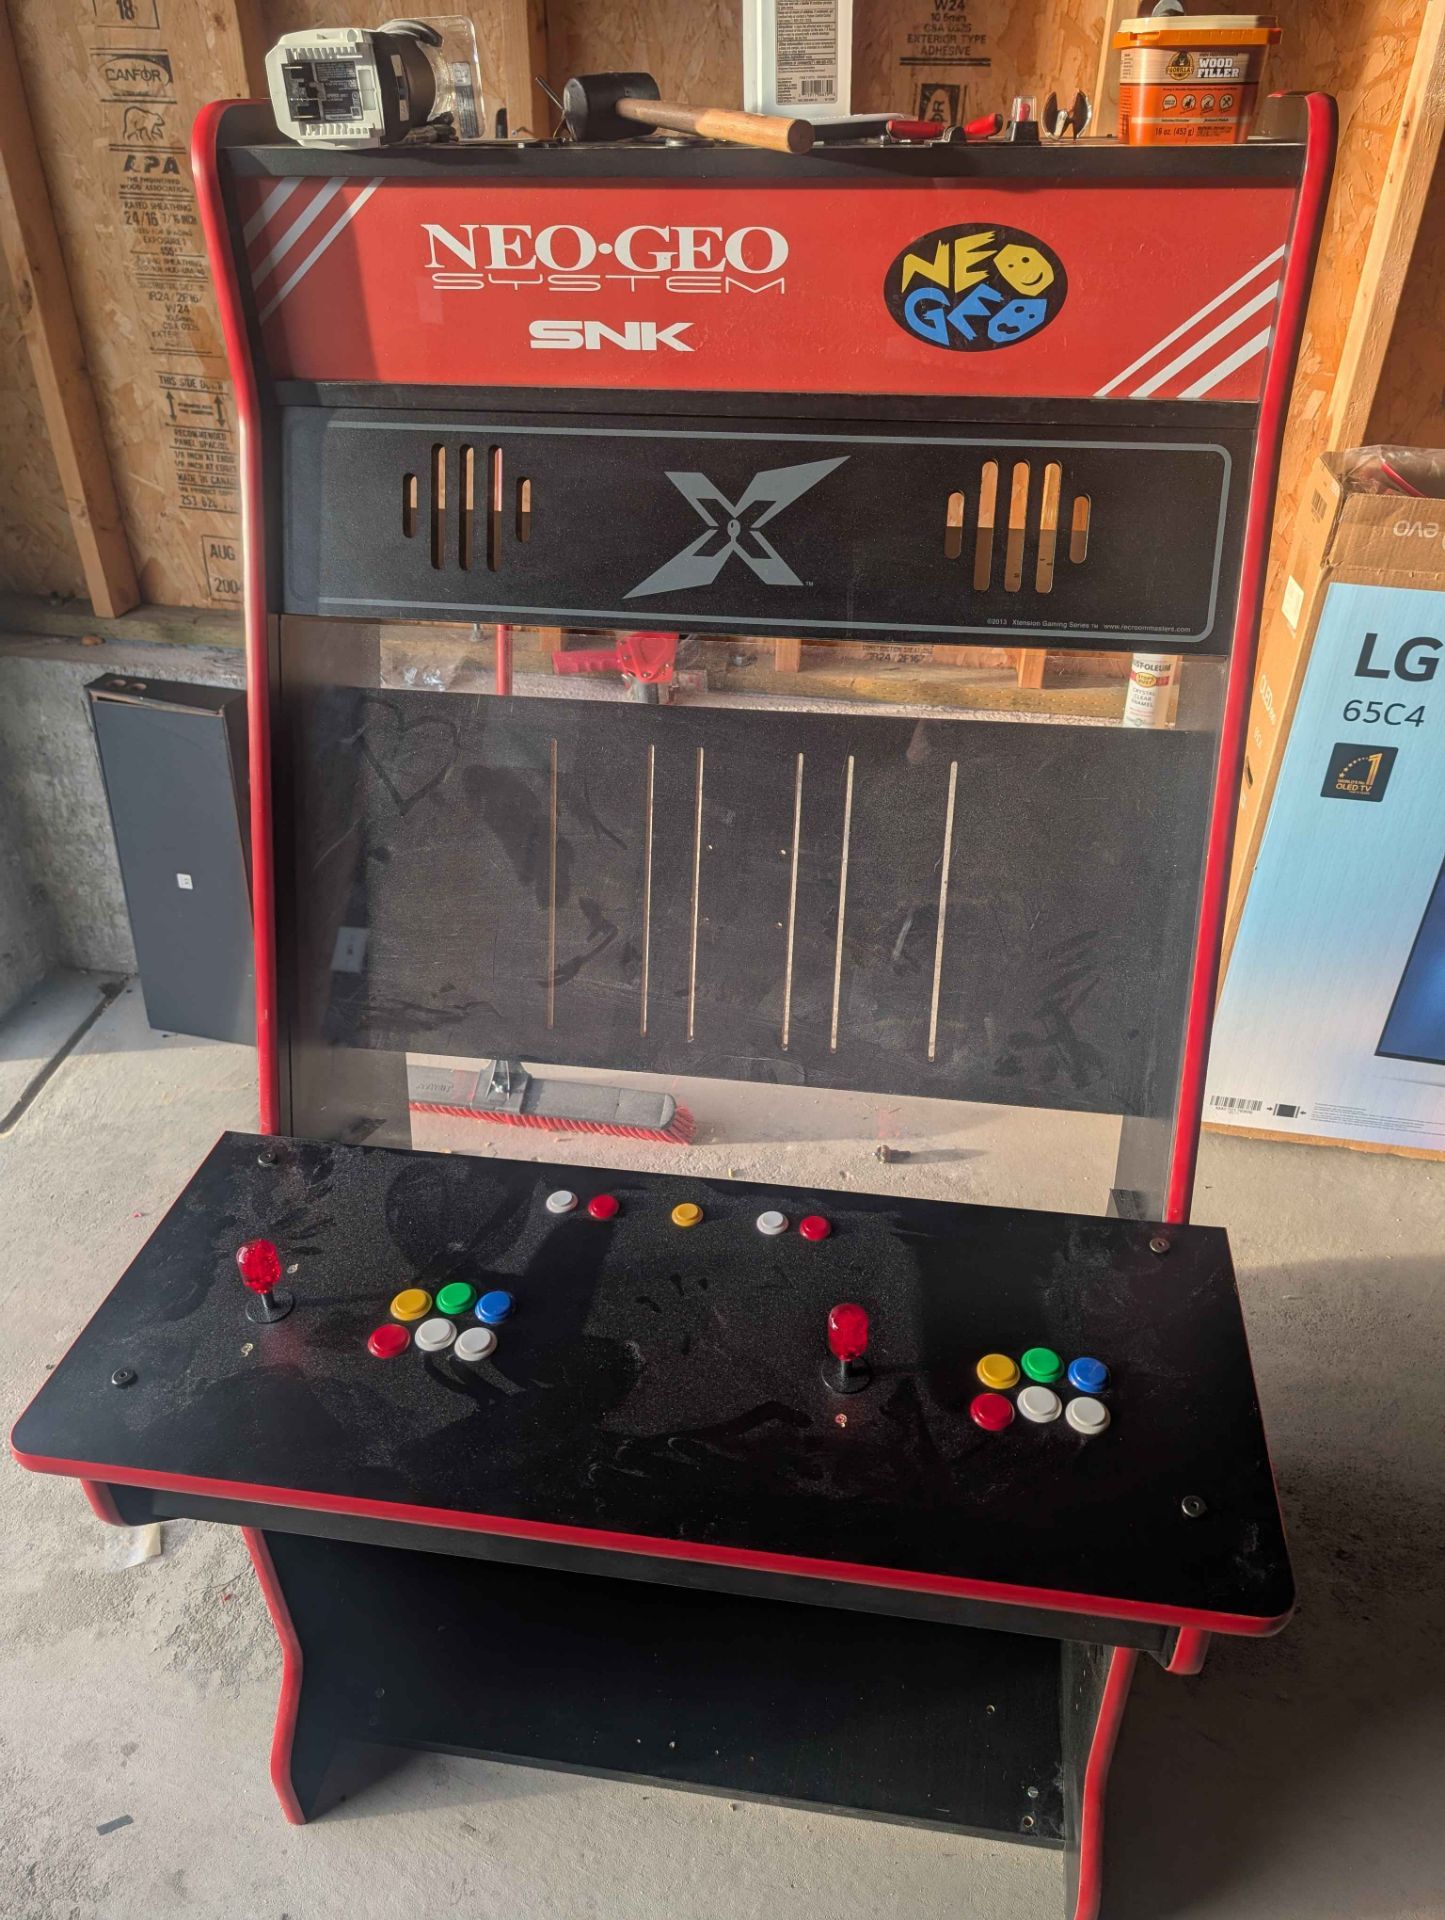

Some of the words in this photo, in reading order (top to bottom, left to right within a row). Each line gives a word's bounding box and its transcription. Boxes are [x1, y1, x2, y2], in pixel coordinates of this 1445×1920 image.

[907, 34, 957, 44] EXTERIOR
[961, 34, 986, 44] TYPE
[921, 45, 971, 56] ADHESIVE
[1199, 58, 1233, 68] WOOD
[105, 66, 161, 84] CANFOR
[1197, 68, 1240, 78] FILLER
[124, 154, 180, 175] APA
[124, 202, 148, 210] RATED
[150, 203, 193, 212] SHEATHING
[124, 211, 159, 227] 24/16
[143, 235, 180, 245] EXPOSURE
[901, 231, 1055, 297] NEO
[432, 273, 785, 295] SYSTEM
[905, 283, 1048, 346] GEO
[528, 320, 695, 352] SNK
[158, 375, 177, 386] THIS
[180, 377, 197, 389] SIDE
[174, 428, 227, 441] RECOMMENDED
[174, 437, 196, 447] PANEL
[187, 451, 204, 461] INCH
[176, 472, 197, 482] MADE
[1393, 520, 1440, 539] evo
[210, 543, 236, 561] AUG
[214, 577, 243, 594] 200
[1012, 618, 1041, 627] Xtension
[1042, 620, 1068, 630] Gaming
[1069, 621, 1090, 629] Series
[1354, 632, 1444, 682] LG
[1343, 699, 1426, 727] 65C4
[1336, 783, 1359, 791] OLED
